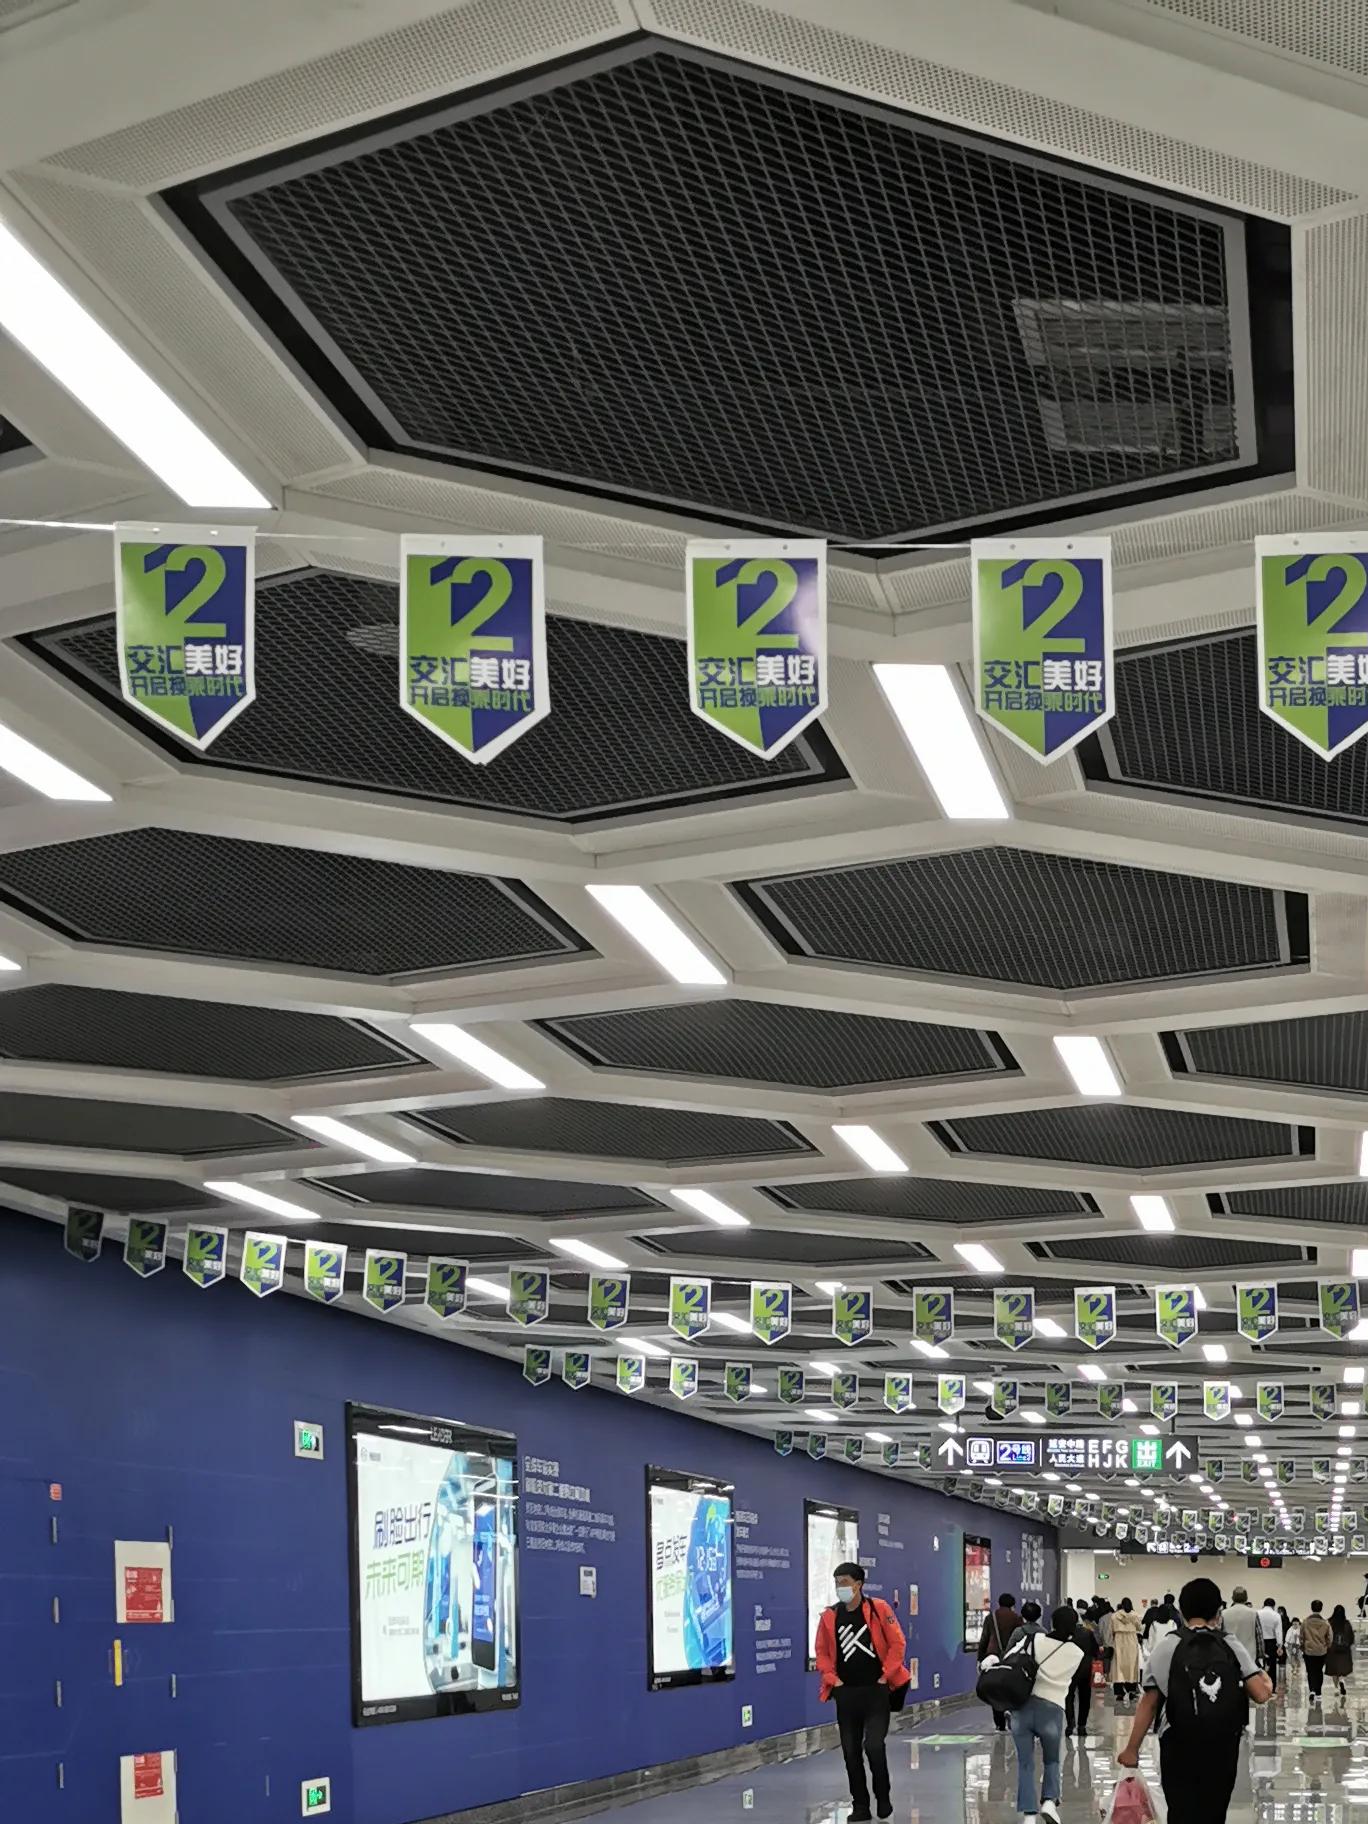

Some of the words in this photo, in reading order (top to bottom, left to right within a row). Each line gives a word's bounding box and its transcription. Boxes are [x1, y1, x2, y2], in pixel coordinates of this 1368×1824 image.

[128, 644, 242, 675] 交汇美好
[409, 655, 531, 691] 交汇美好
[698, 655, 815, 686] 交汇美好
[131, 676, 242, 697] 开启换乘时代
[984, 659, 1102, 691] 交汇美好
[410, 686, 531, 712] 开启换乘时代
[698, 687, 817, 708] 开启换乘时代
[985, 689, 1102, 712] 开启换乘时代
